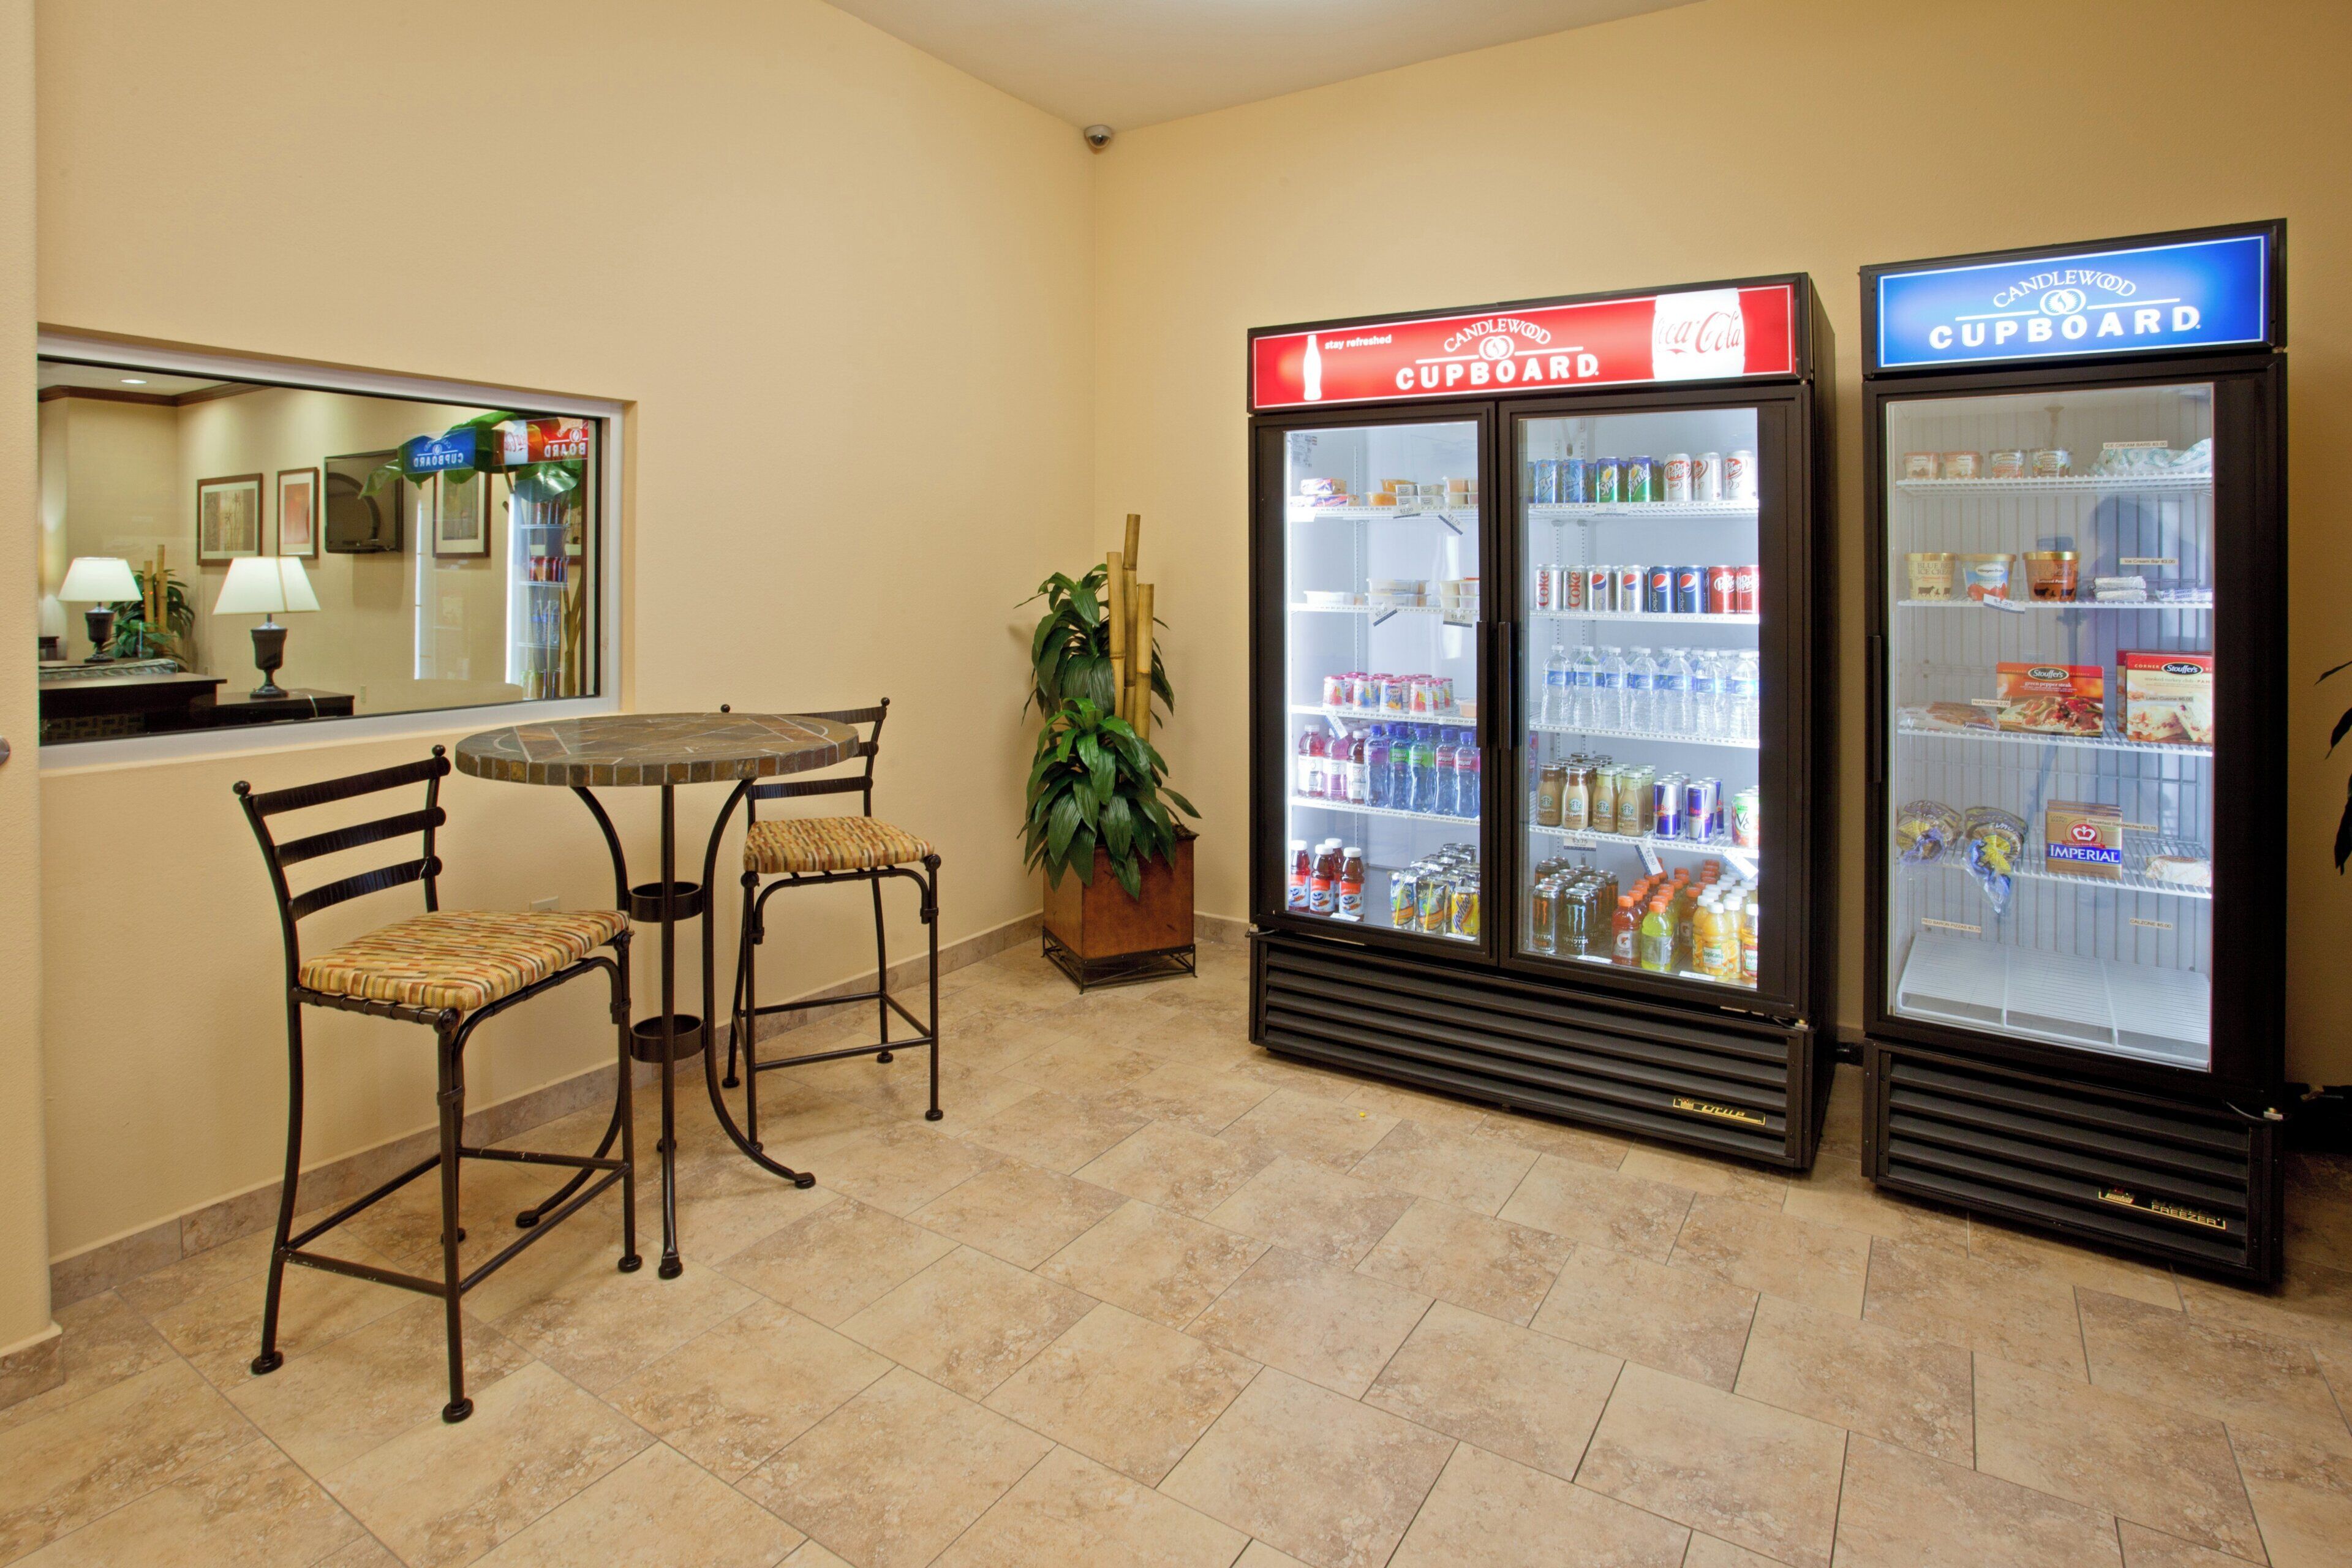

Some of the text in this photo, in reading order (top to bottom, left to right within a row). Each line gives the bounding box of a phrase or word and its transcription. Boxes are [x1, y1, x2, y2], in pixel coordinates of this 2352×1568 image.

[1993, 270, 2137, 307] CANDLEWOOD
[1324, 334, 1392, 350] stay refreshed
[1444, 318, 1551, 352] CANDLEWOOD
[1656, 311, 1741, 354] Coca-Cola
[1538, 571, 1550, 606] Coke
[1568, 571, 1581, 607] Coke
[2033, 669, 2064, 679] Stouffer's
[2166, 665, 2198, 674] Stouffer's
[2049, 844, 2120, 863] IMPERIAL
[2151, 1204, 2217, 1226] FREEZER
